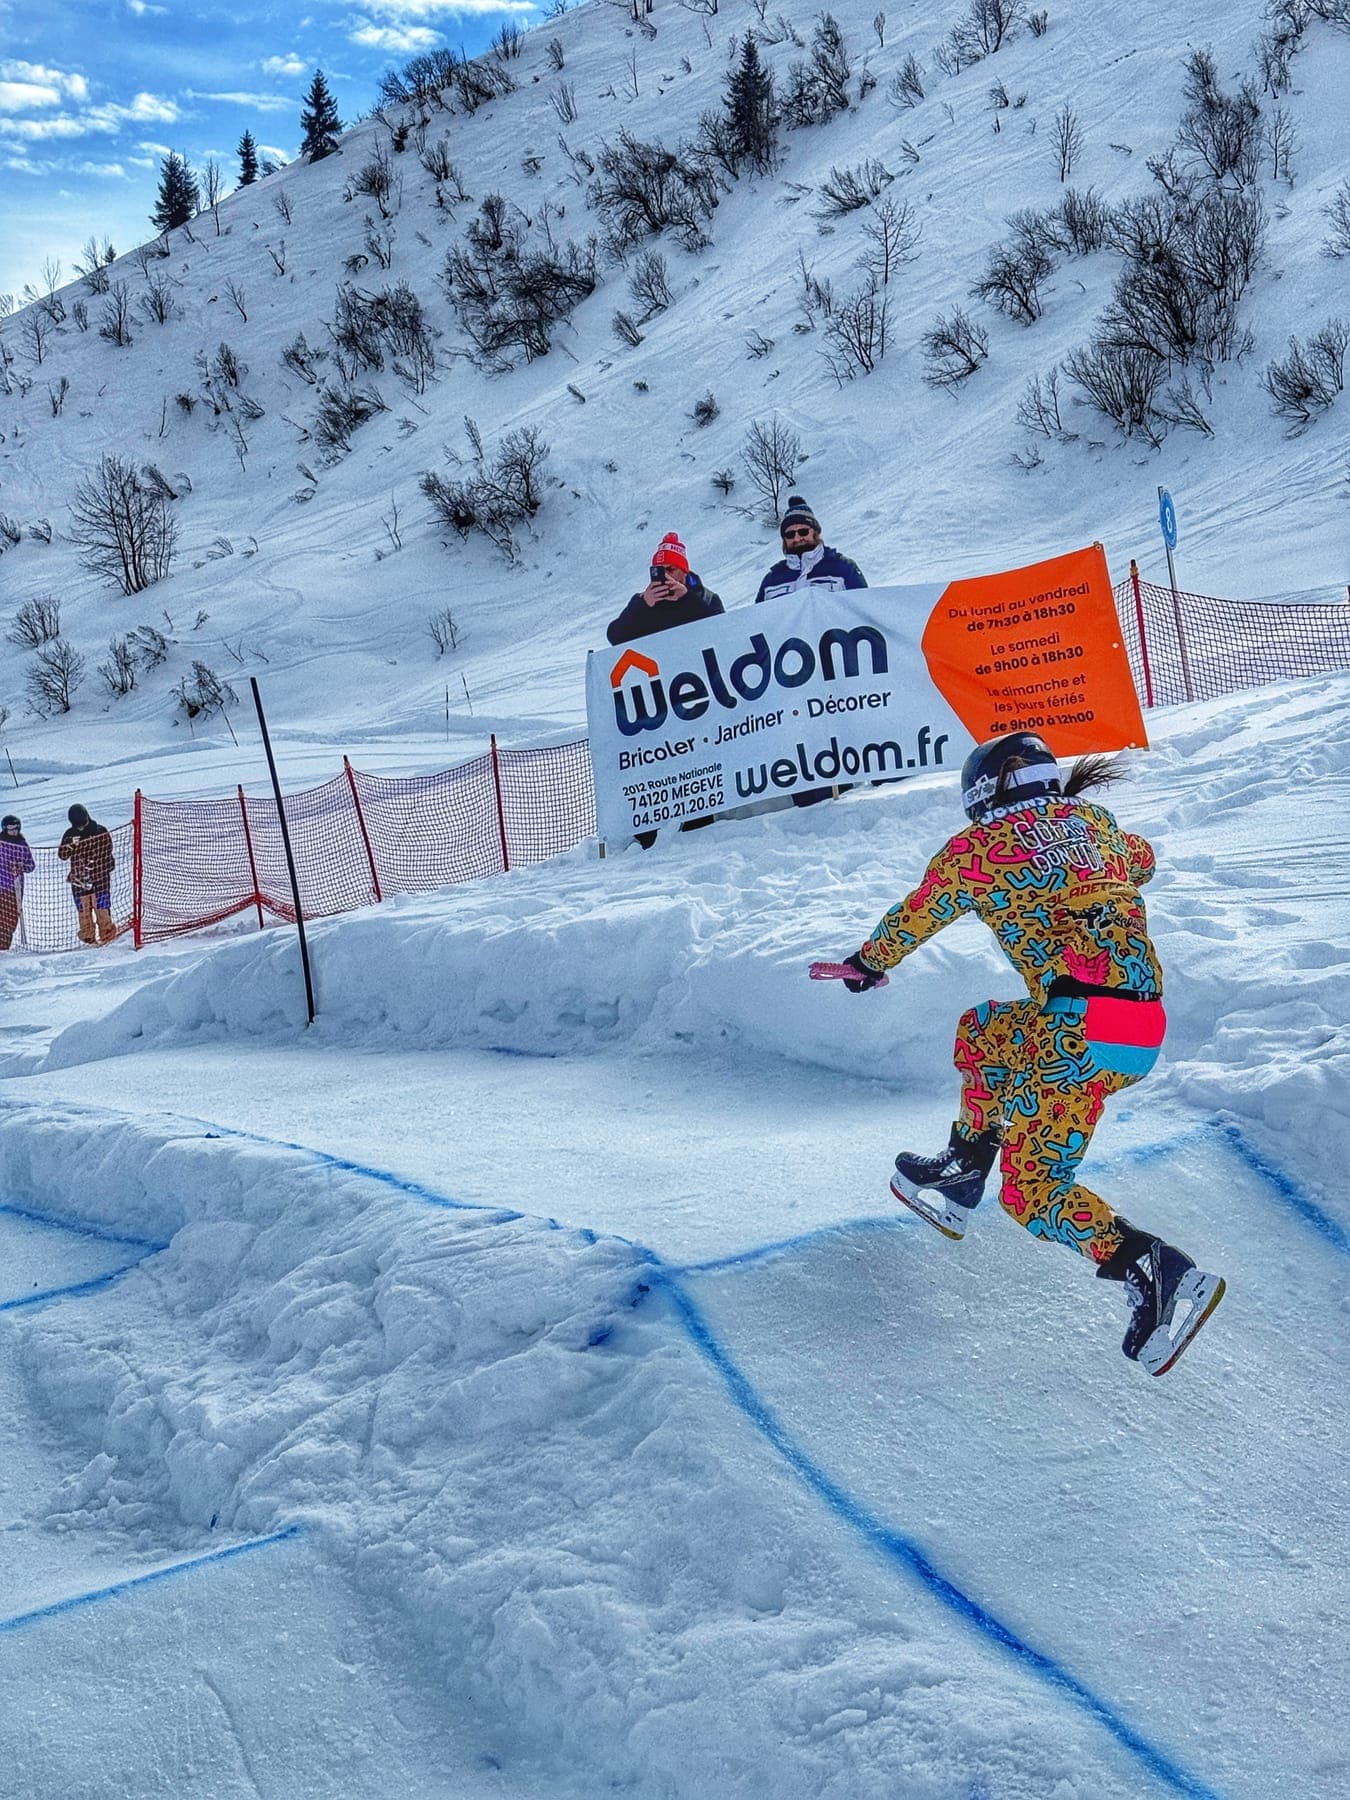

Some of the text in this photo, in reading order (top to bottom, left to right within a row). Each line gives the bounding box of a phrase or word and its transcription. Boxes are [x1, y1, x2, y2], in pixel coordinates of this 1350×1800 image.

[948, 582, 1091, 619] Du lundi au vendredi
[966, 602, 1076, 632] de 7h30 à 18h30
[974, 645, 1084, 676] de 9h00 à 18h30
[990, 631, 1061, 656] Le samedi
[612, 625, 889, 737] weldom
[986, 673, 1087, 698] Le dimanche et
[989, 709, 1095, 733] de 9h00 à 12h00
[993, 691, 1086, 714] les jours fériés
[618, 689, 893, 771] Bricoler Jardiner Décorer
[622, 761, 723, 798] 2012 Route Nationale
[735, 725, 950, 798] weldom.fr
[628, 773, 724, 811] 74120 MEGEVE
[631, 791, 725, 828] 04.50.21.20.62
